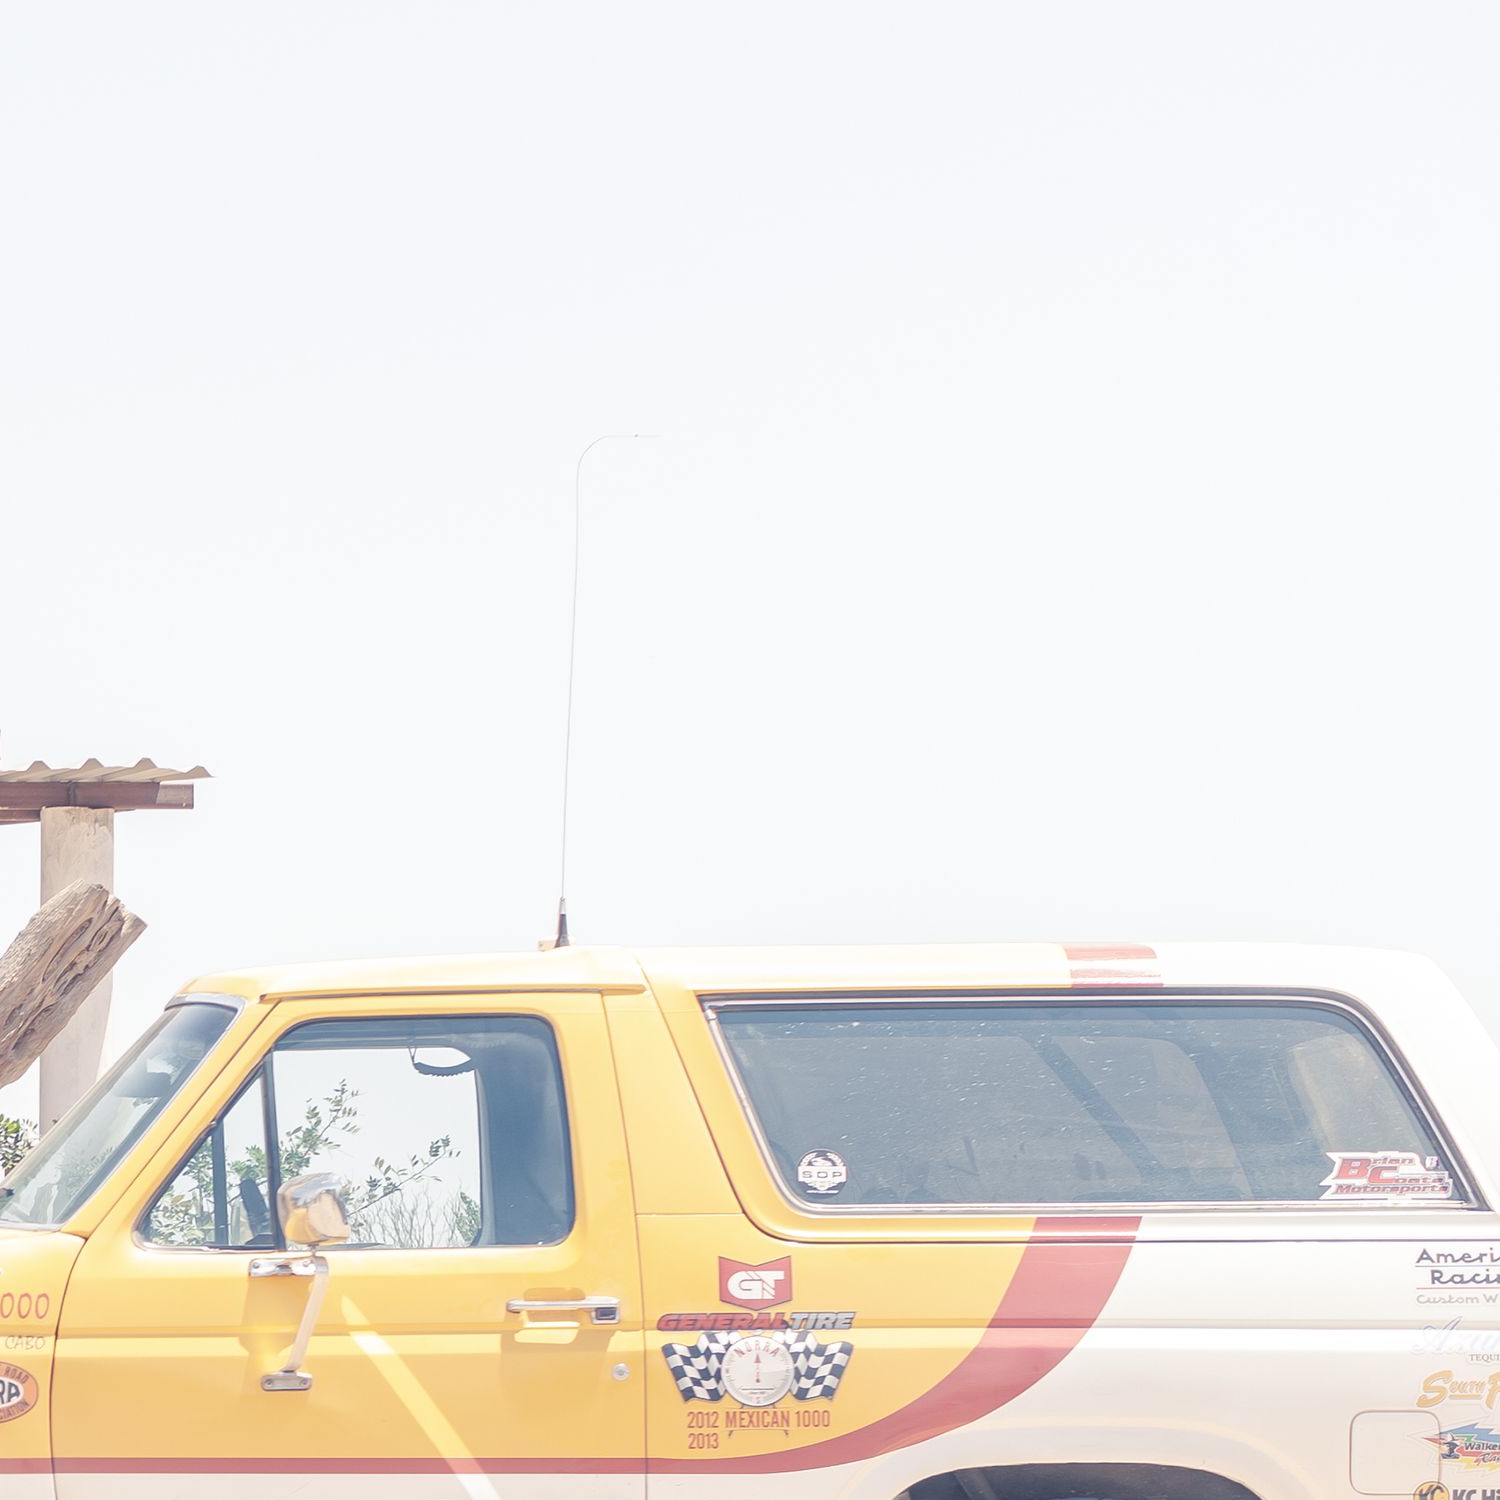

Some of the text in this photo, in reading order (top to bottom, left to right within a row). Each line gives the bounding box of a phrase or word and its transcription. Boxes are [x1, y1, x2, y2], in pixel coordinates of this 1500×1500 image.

[1416, 1247, 1500, 1263] Ameri
[728, 1270, 785, 1299] GT
[1416, 1294, 1480, 1304] Custom
[5, 1335, 46, 1350] CABO
[4, 1364, 29, 1384] ROAD
[687, 1410, 831, 1428] 2012 MEXICAN 1000
[688, 1433, 719, 1449] 2013
